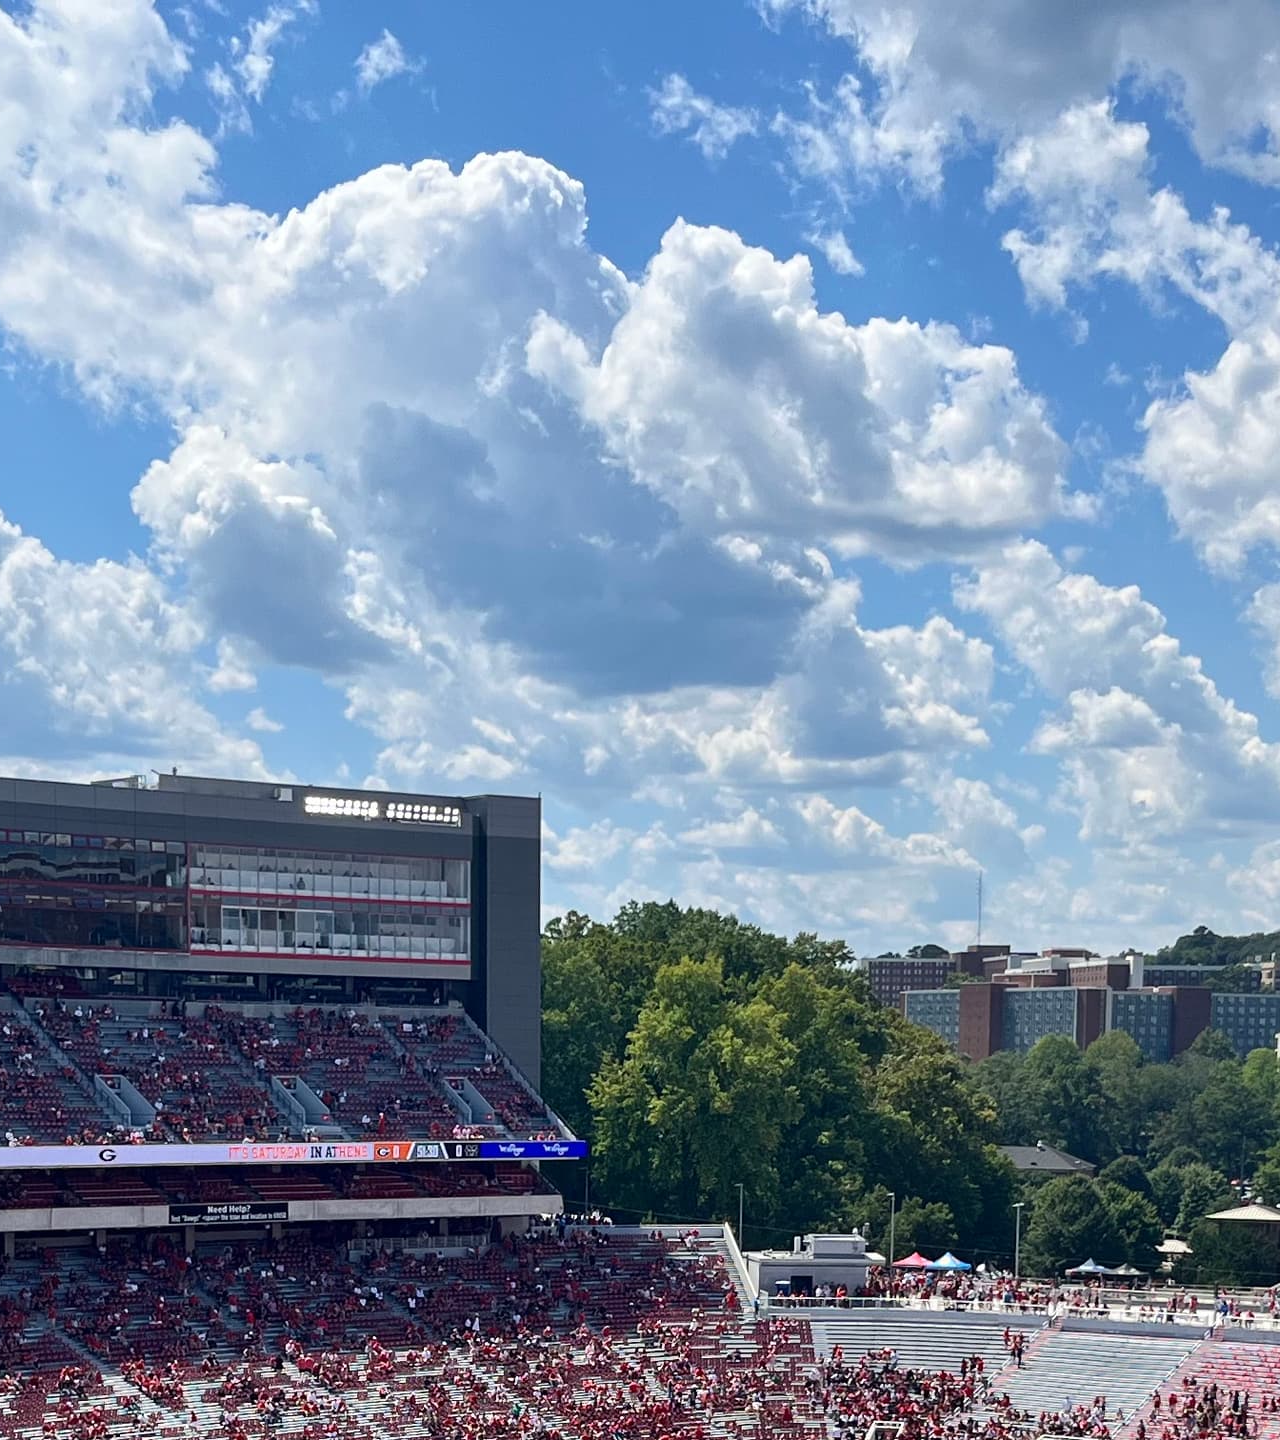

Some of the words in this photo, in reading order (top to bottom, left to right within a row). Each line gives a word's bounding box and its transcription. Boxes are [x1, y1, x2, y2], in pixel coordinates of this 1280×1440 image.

[99, 1148, 117, 1162] G
[252, 1145, 308, 1159] SATURDAY
[310, 1145, 323, 1159] IN
[325, 1145, 368, 1158] ATHENS
[207, 1205, 227, 1214] Need
[228, 1204, 251, 1214] Help?
